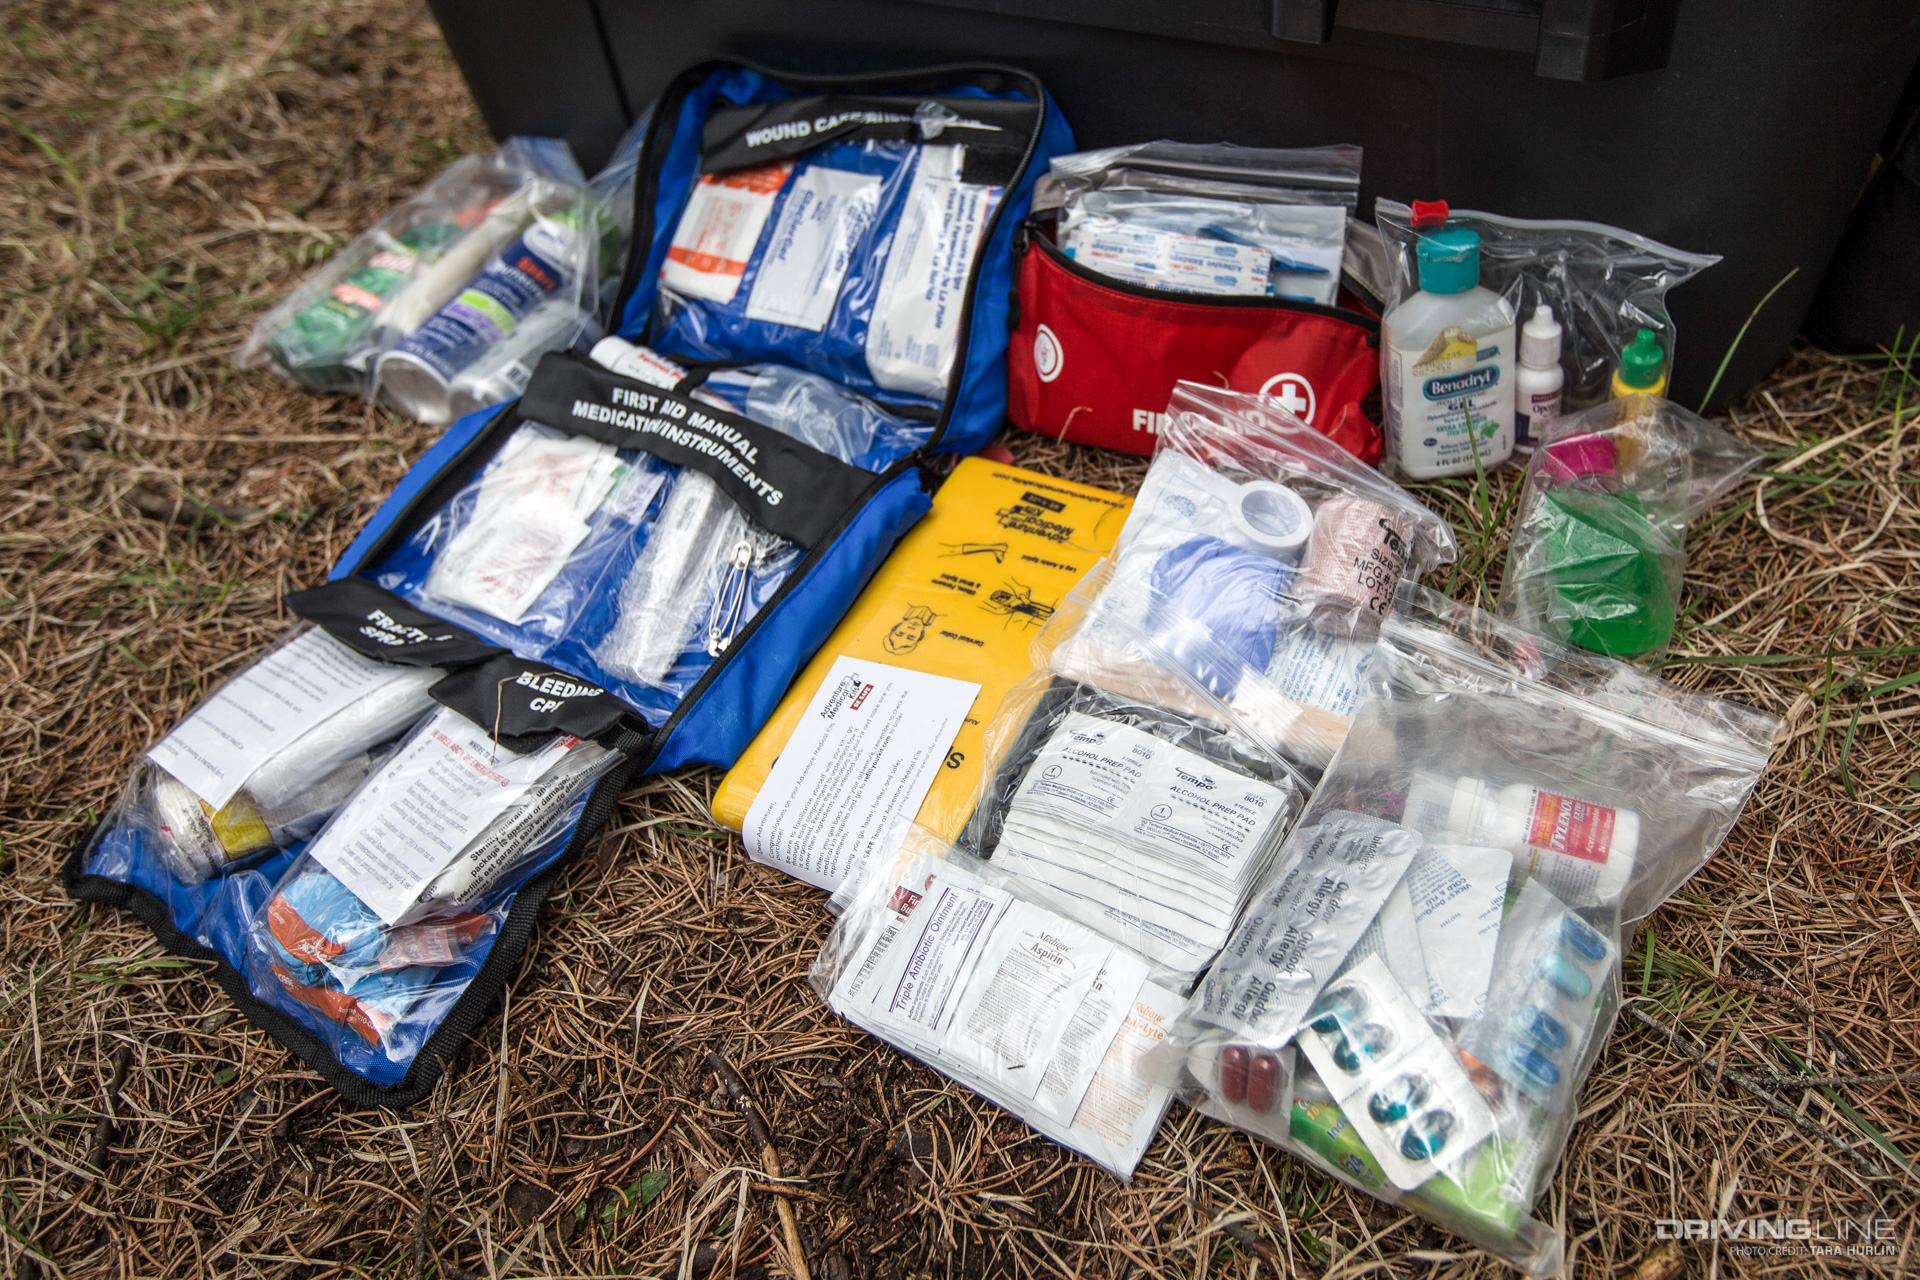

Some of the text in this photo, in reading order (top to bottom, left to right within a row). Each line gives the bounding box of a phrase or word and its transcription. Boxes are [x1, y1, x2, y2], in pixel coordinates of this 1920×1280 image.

[745, 119, 811, 148] WOUND
[1430, 369, 1491, 395] Benadryl
[612, 387, 758, 465] FIRST AID MANUAL
[1021, 504, 1044, 518] Kits
[1023, 515, 1074, 537] Medical
[1006, 520, 1070, 545] Adventure
[1351, 556, 1384, 579] MFG
[939, 629, 984, 647] Cervical Collar
[517, 671, 604, 698] BLEEDING
[819, 680, 846, 718] Adventure
[847, 685, 860, 699] Kits
[826, 687, 850, 720] Medical
[1067, 727, 1103, 748] Tempo
[1131, 746, 1151, 760] 8010
[1061, 745, 1142, 779] ALCOHOL PREP PAD
[1172, 765, 1215, 793] Tempo
[767, 732, 828, 859] Congratulations Adventure Medical
[790, 744, 850, 866] through each compartment understand
[792, 796, 814, 829] familiarize
[810, 773, 827, 796] yourself
[823, 759, 834, 773] with
[796, 757, 850, 861] organized. Review medications
[806, 834, 817, 851] their
[813, 800, 835, 835] ingredients
[831, 787, 842, 800] and
[838, 761, 855, 788] intended
[853, 747, 864, 762] uses.
[815, 721, 891, 873] When you get back from your adventure, remember
[822, 734, 892, 876] medical supplies and refillyourkit.com
[851, 756, 903, 853] you faster, further, and safer,
[862, 759, 917, 860] SAFE Team Adventure Medical
[1159, 806, 1165, 815] 1
[1169, 783, 1257, 827] ALCOHOL PREP PAD
[1232, 801, 1257, 816] STERILE
[1243, 794, 1264, 808] 8010
[1572, 801, 1582, 820] EXTRA
[469, 844, 502, 878] package
[505, 811, 534, 841] opened
[531, 804, 542, 815] or
[538, 773, 573, 808] damaged
[754, 800, 777, 837] Adventurer,
[1224, 830, 1244, 843] Alcohol
[1548, 797, 1573, 851] TYLENOL
[469, 831, 500, 863] Sterility
[482, 822, 536, 877] est garanti sauf
[829, 829, 849, 878] replacements.
[1270, 867, 1299, 908] Outdoor
[1304, 876, 1336, 917] Allergy
[1319, 879, 1351, 925] Outdoor
[1424, 894, 1439, 908] FLU
[1445, 875, 1467, 893] COLD
[895, 891, 959, 1012] Triple Antibiotic Ointment
[1028, 941, 1065, 968] Aspirin
[1234, 915, 1264, 959] Outdoor
[1267, 924, 1299, 968] Allergy
[1281, 929, 1315, 976] Outdoor
[1229, 975, 1263, 1021] Allergy
[1244, 980, 1277, 1029] Outdoor
[1343, 1152, 1366, 1174] 24
